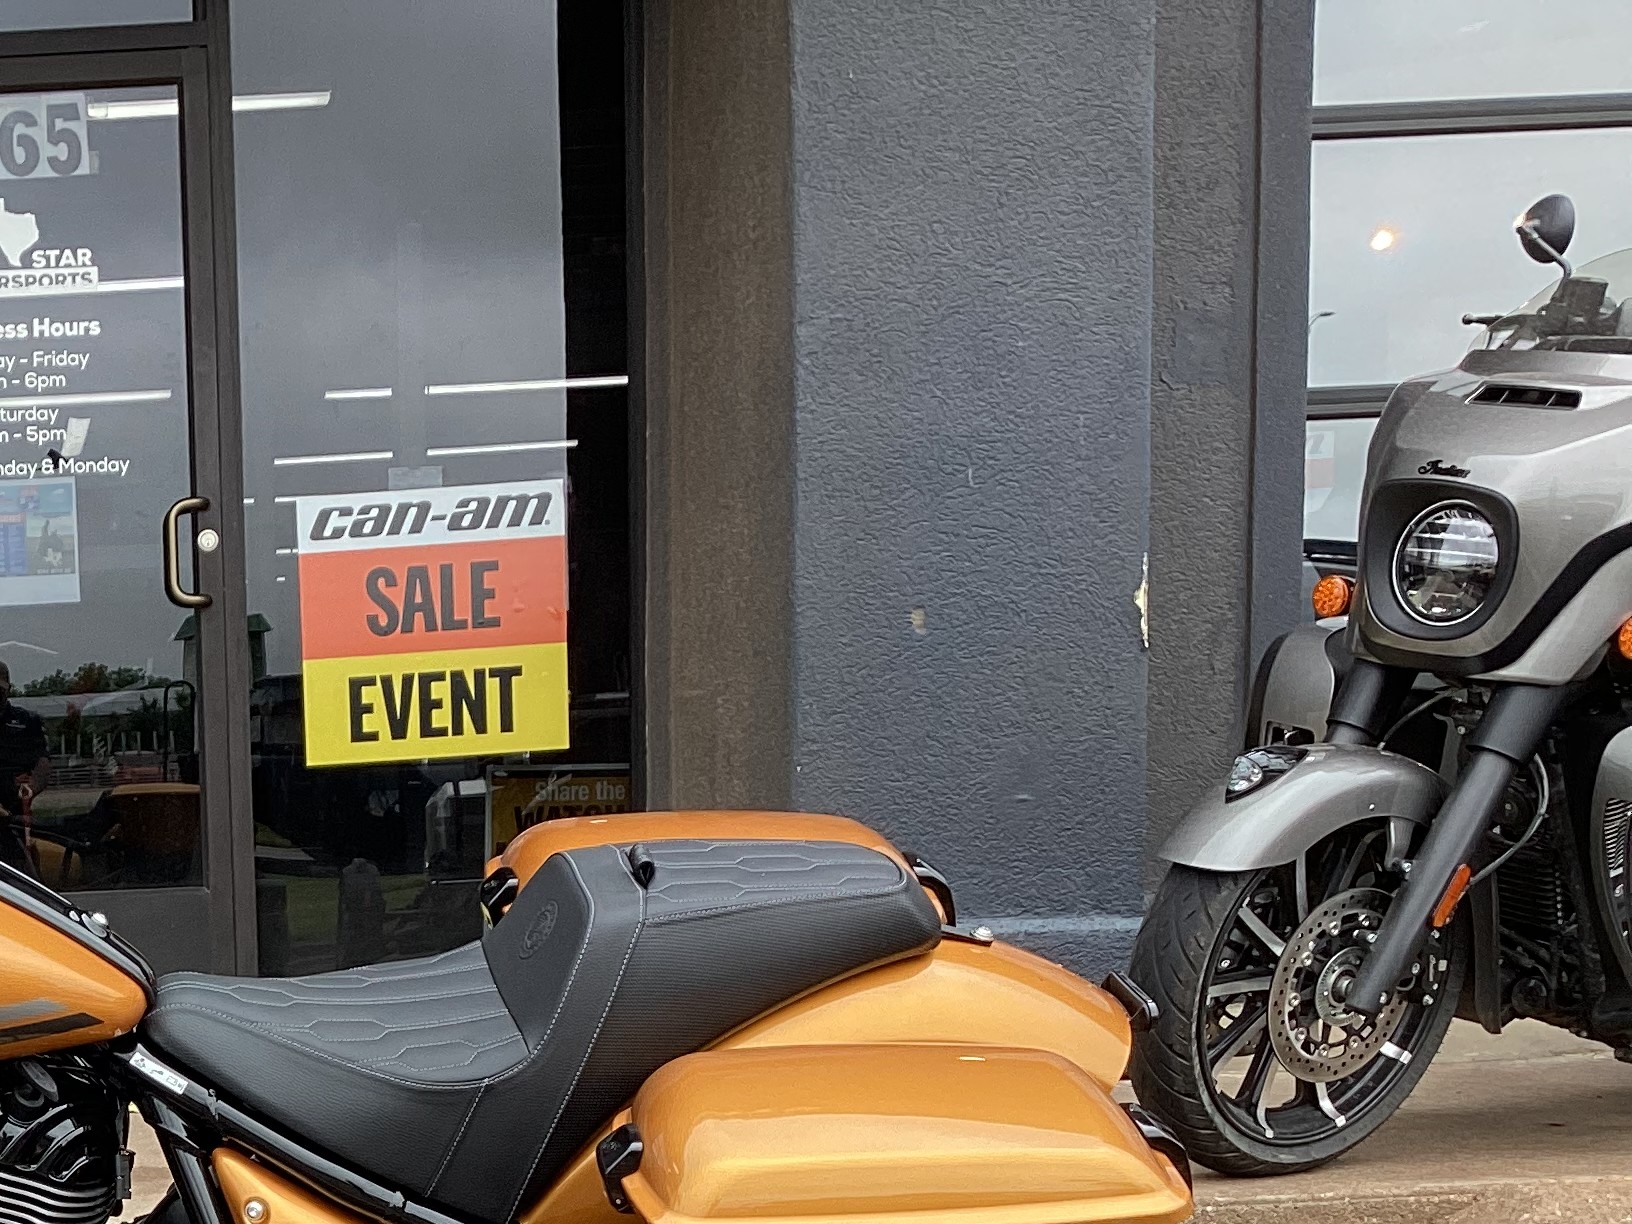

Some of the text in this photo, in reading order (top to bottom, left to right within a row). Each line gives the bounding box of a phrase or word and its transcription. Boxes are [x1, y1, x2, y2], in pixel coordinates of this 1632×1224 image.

[31, 248, 93, 268] STAR
[32, 318, 101, 337] Hours
[32, 350, 90, 368] Friday
[24, 372, 66, 391] 6pm
[26, 425, 67, 445] 5pm
[41, 459, 55, 475] &
[58, 457, 130, 476] Monday
[365, 559, 501, 637] SALE
[348, 665, 523, 743] EVENT
[596, 781, 626, 800] the
